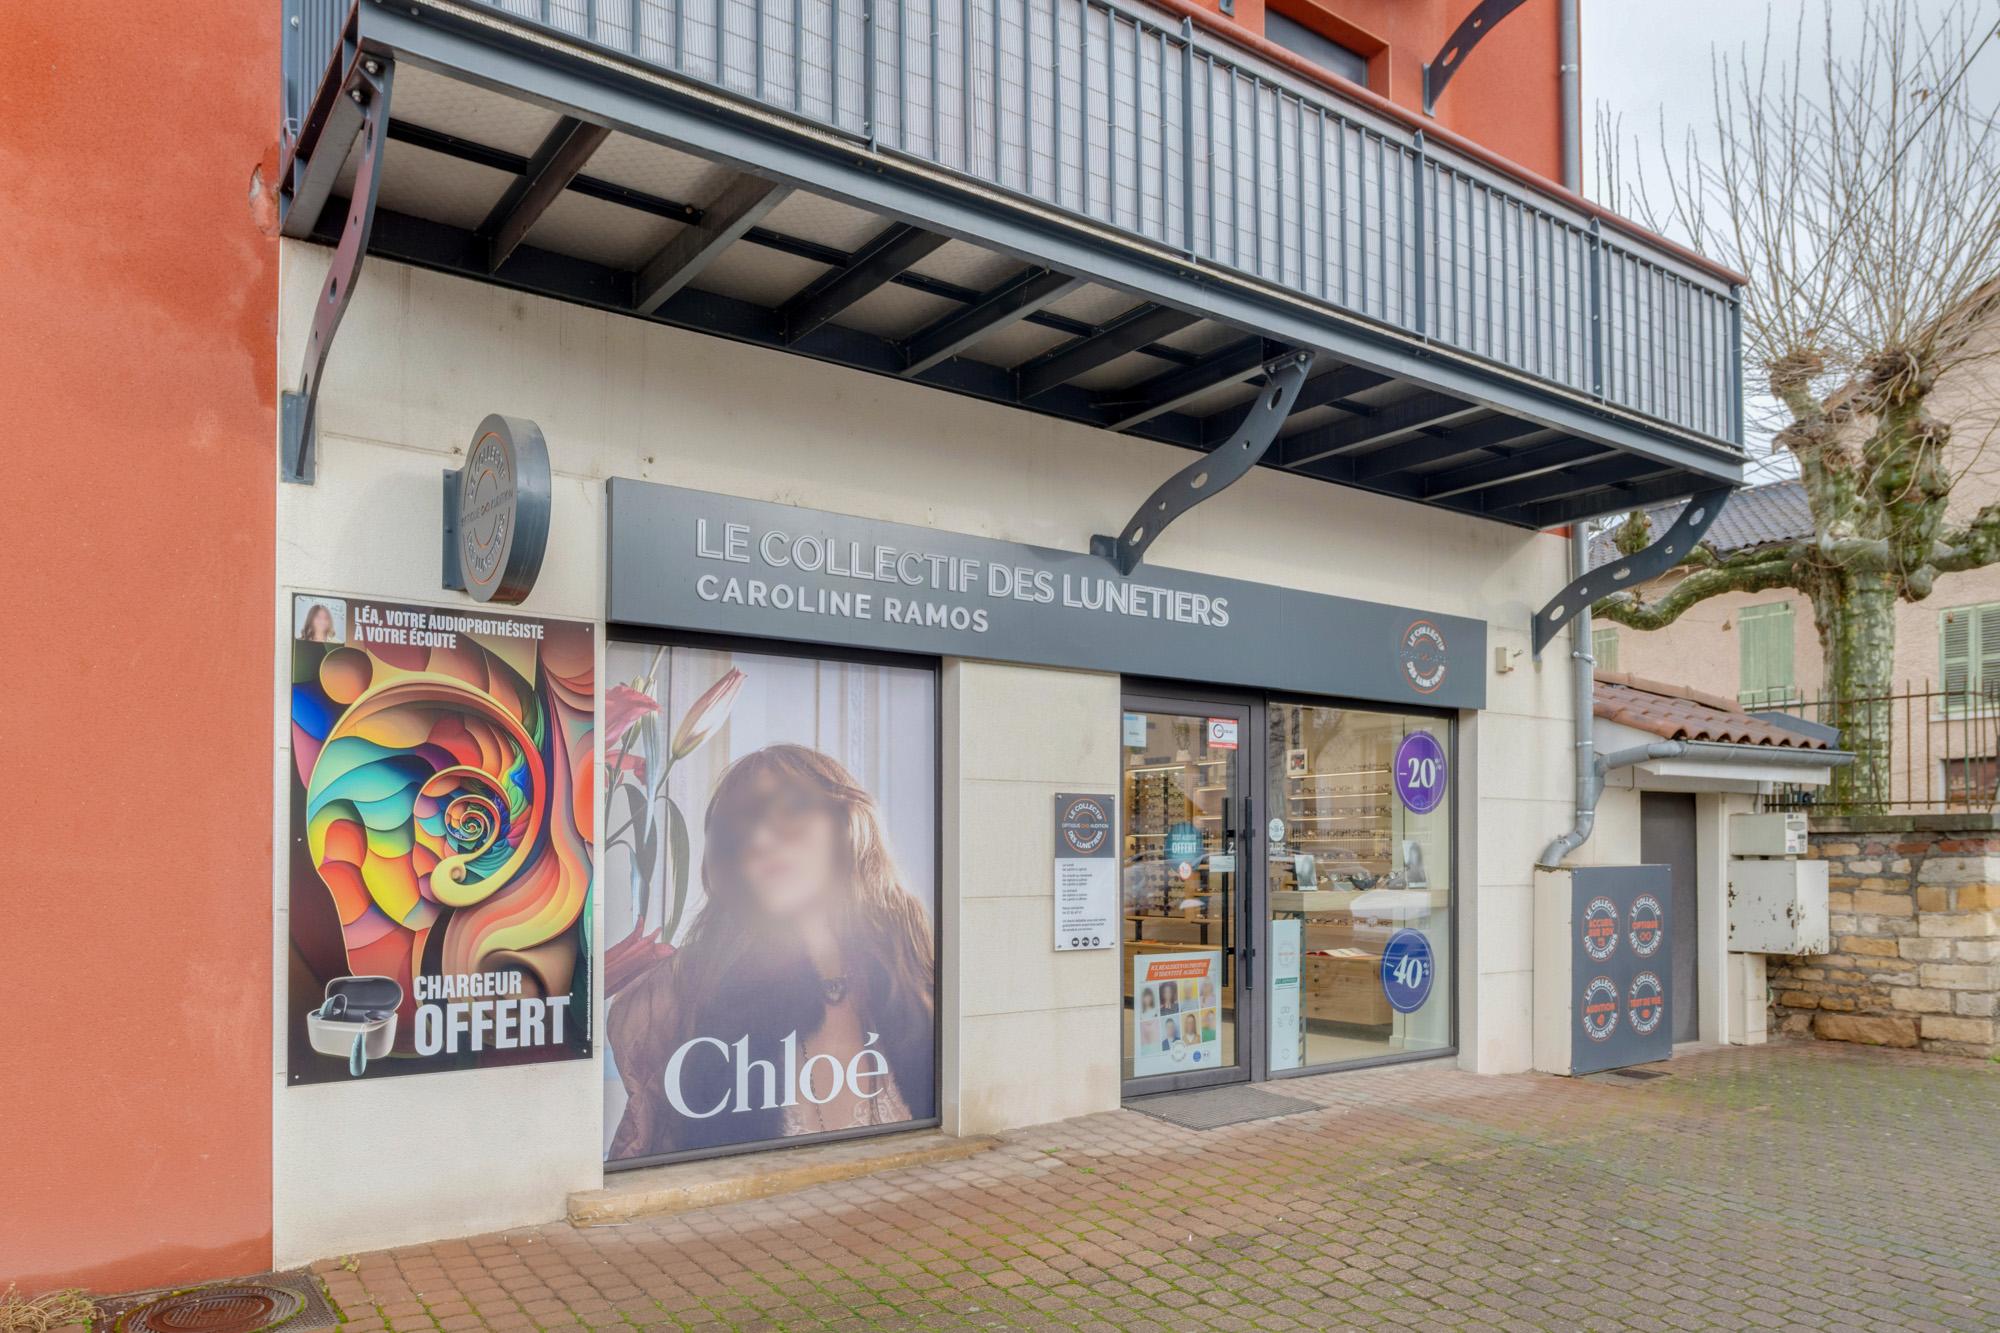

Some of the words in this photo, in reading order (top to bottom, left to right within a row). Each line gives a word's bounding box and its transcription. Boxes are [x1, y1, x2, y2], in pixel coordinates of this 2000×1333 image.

[695, 518, 751, 564] LE
[759, 530, 981, 594] COLLECTIF
[987, 561, 1055, 604] DES
[1062, 573, 1230, 628] LUNETIERS
[354, 605, 384, 626] LÉA,
[386, 609, 427, 630] VOTRE
[427, 613, 545, 640] AUDIOPROTHÉSISTE
[695, 574, 873, 620] CAROLINE
[883, 597, 989, 633] RAMOS
[353, 623, 366, 642] À
[365, 629, 408, 646] VOTRE
[408, 628, 457, 650] ÉCOUTE
[1171, 842, 1197, 854] OFFERT
[413, 971, 523, 1001] CHARGEUR
[413, 996, 570, 1057] OFFERT
[663, 1029, 890, 1120] Chloé
